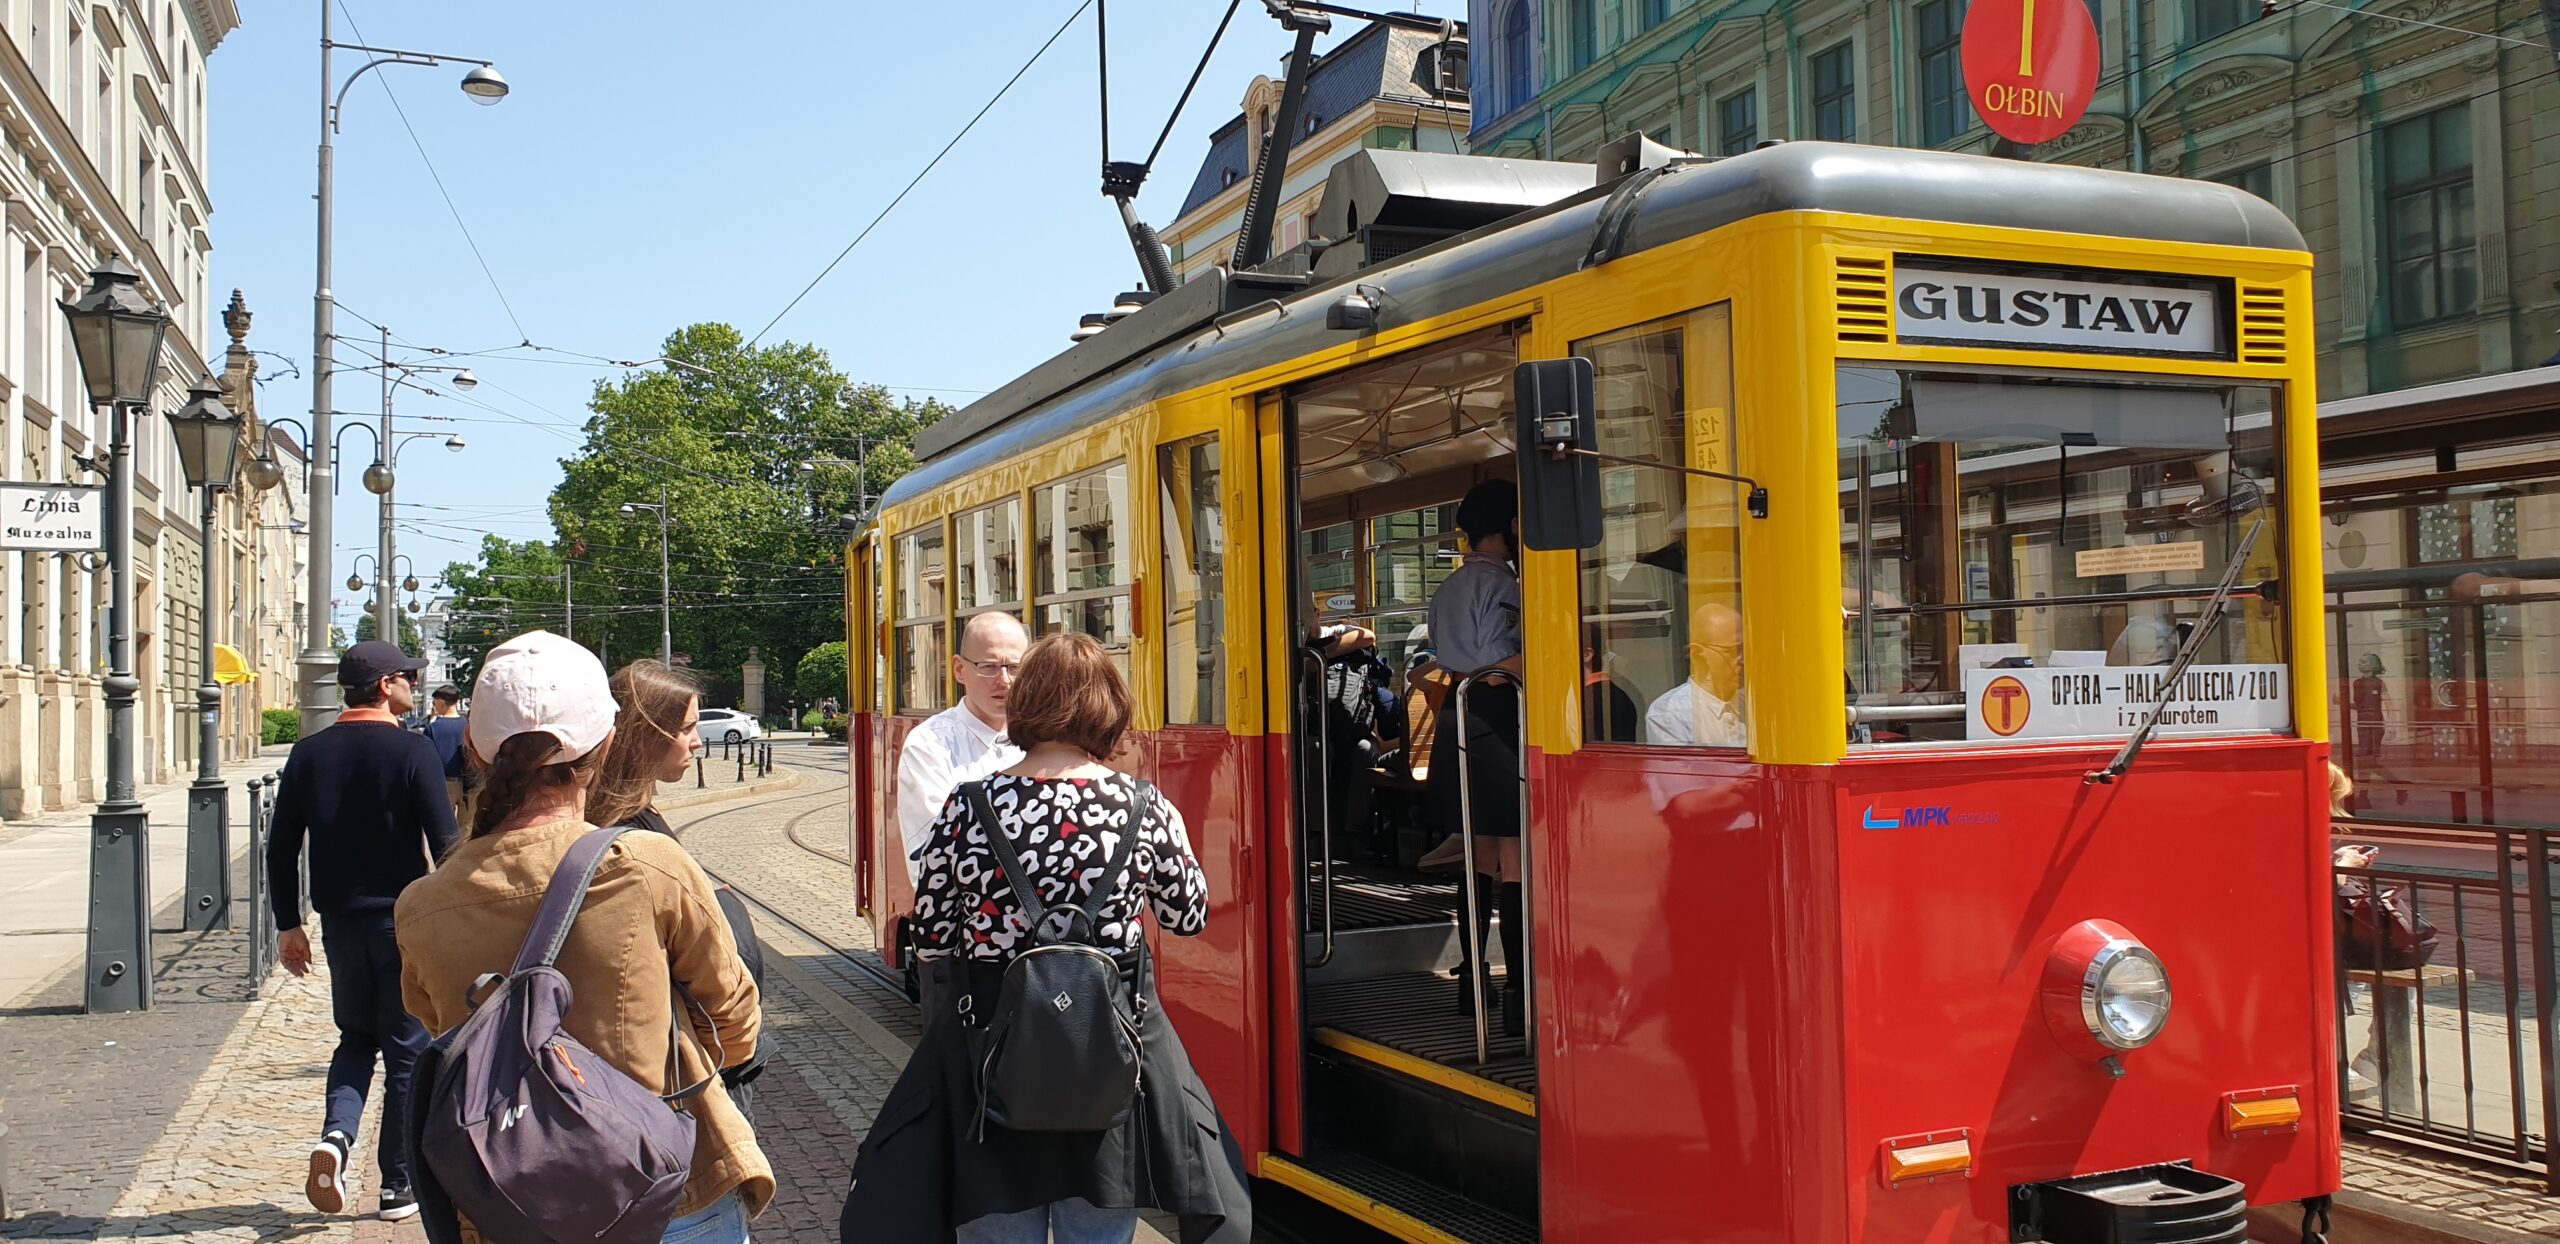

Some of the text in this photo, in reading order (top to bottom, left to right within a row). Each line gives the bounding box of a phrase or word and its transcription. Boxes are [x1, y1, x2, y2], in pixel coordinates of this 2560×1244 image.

[1985, 83, 2064, 119] OŁBIN
[1899, 282, 2193, 336] GUSTAW
[20, 495, 81, 515] Linia
[6, 525, 93, 541] Muzealna
[2051, 674, 2102, 706] OPERA
[2125, 672, 2162, 704] HALA
[2118, 706, 2123, 727] i
[2127, 711, 2137, 727] z
[1903, 806, 1951, 828] MPK
